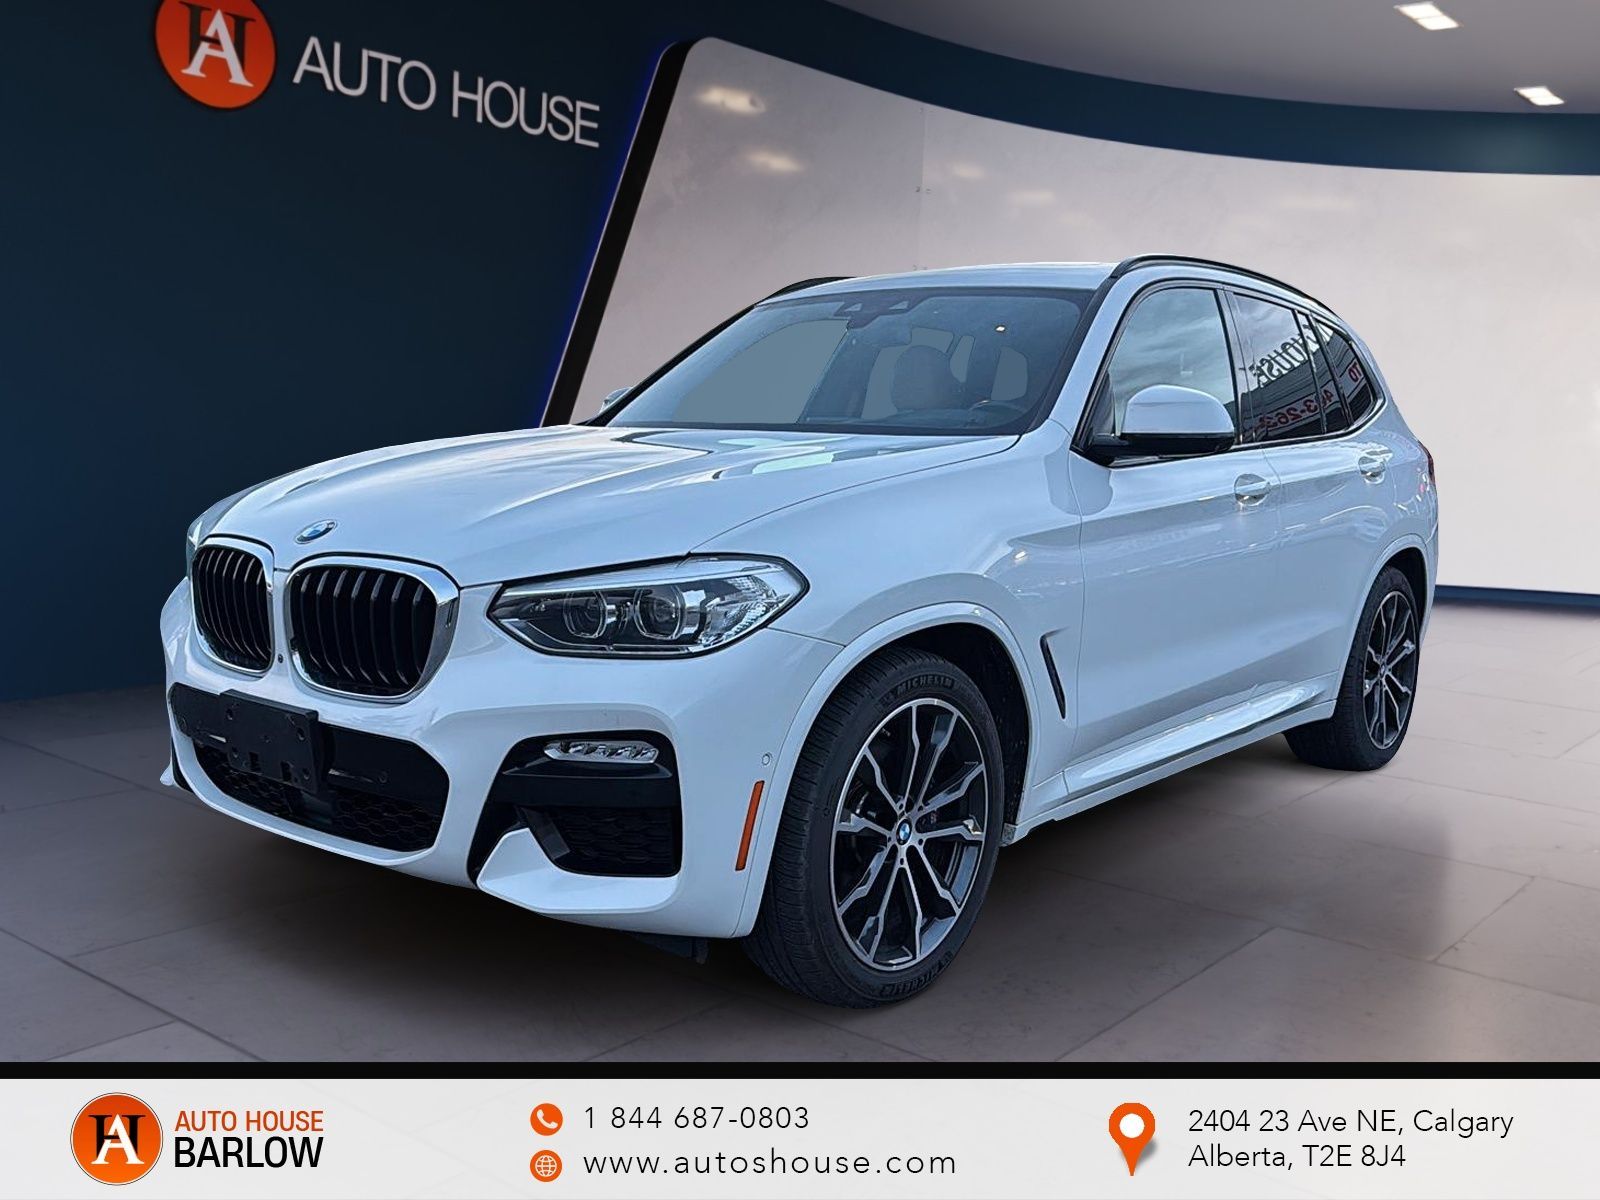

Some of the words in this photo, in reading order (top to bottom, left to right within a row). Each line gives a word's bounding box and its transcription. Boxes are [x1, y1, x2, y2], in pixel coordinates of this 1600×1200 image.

[293, 36, 437, 111] AUTO
[451, 70, 601, 148] HOUSE
[897, 675, 952, 696] MICHELIN
